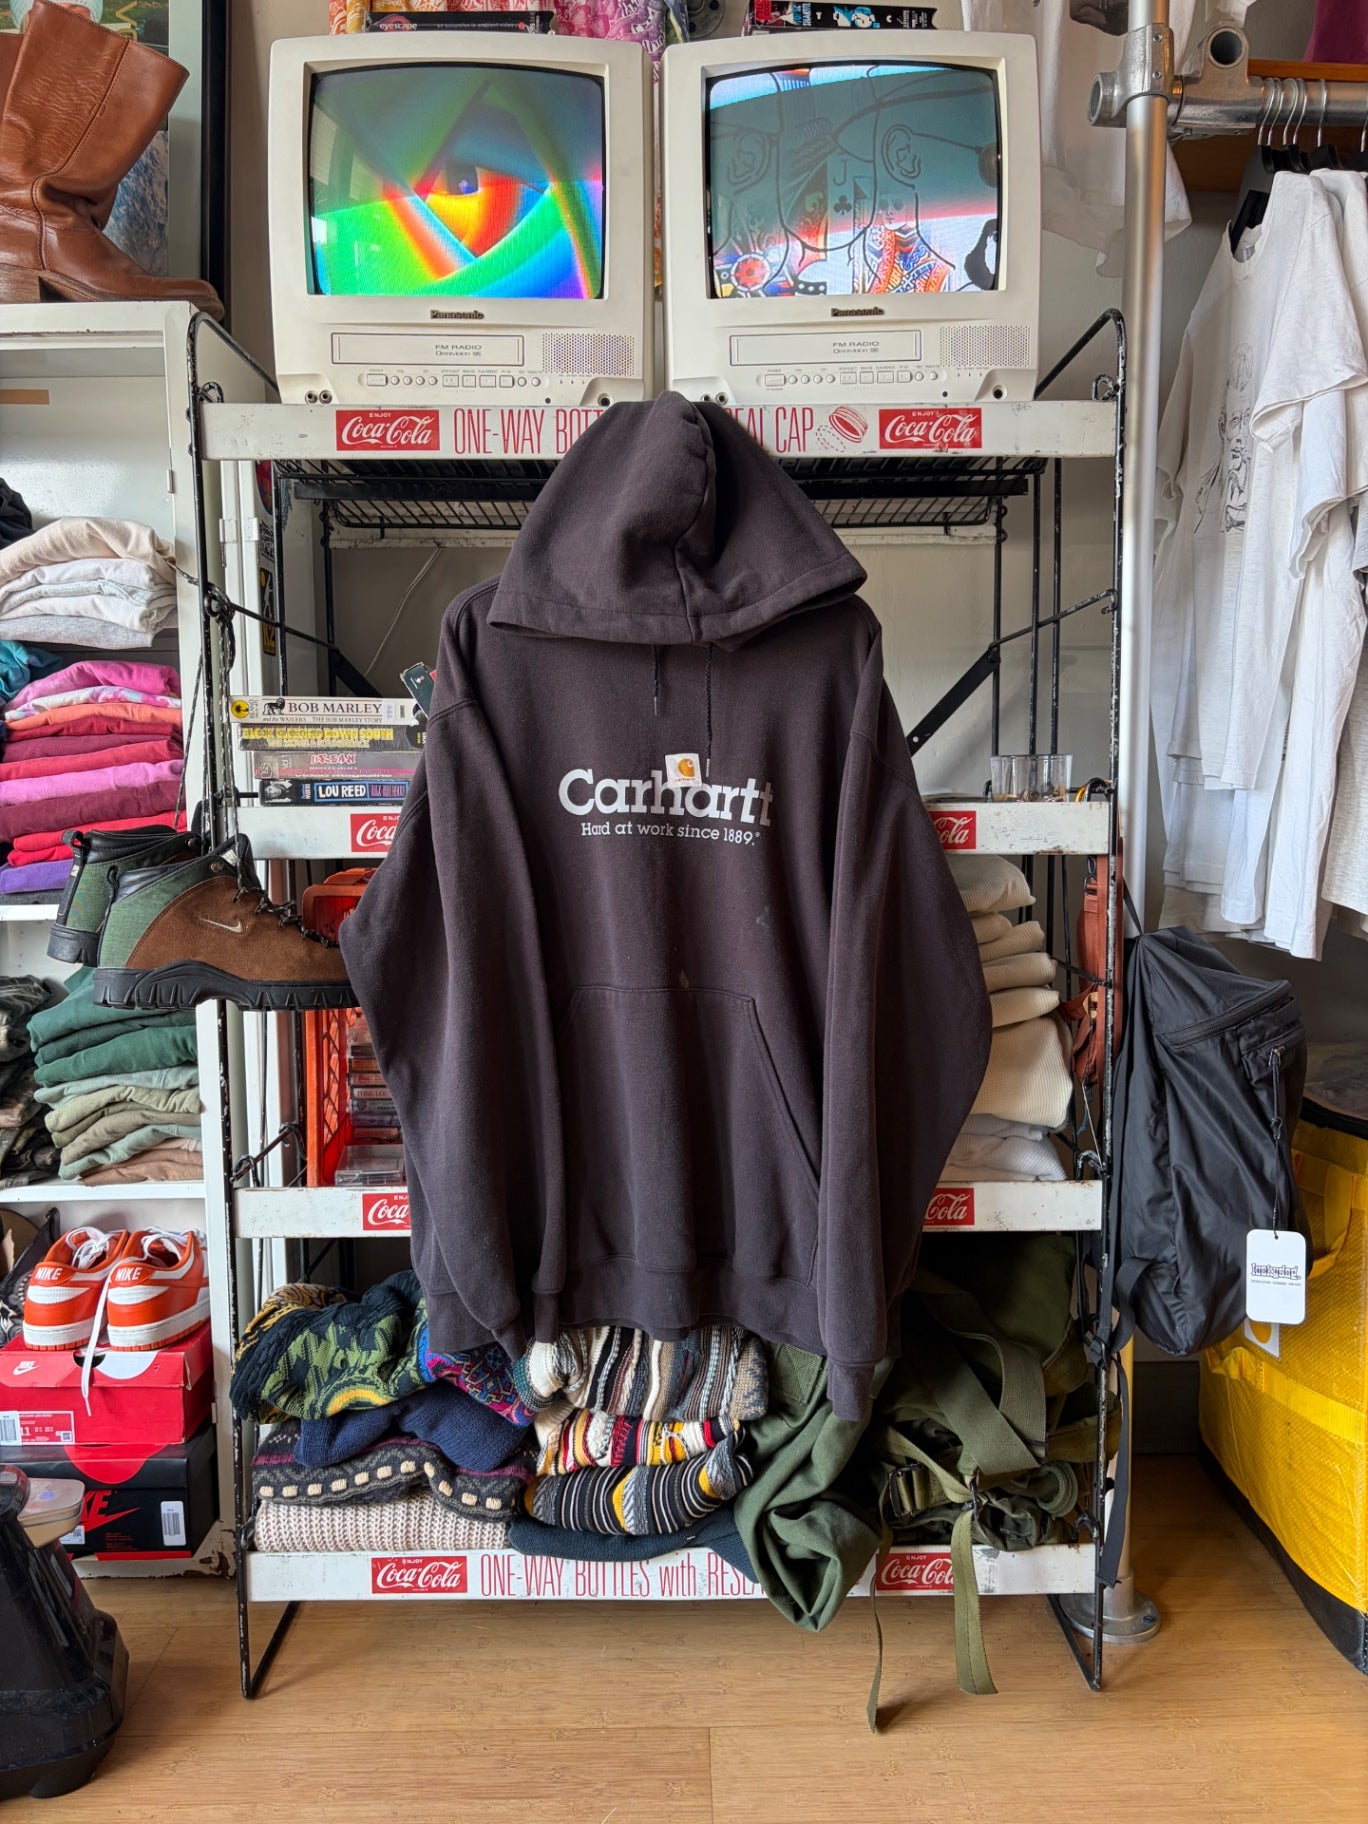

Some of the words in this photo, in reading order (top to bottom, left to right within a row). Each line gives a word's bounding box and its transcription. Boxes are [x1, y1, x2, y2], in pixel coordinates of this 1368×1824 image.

[379, 22, 418, 31] eyescape
[430, 309, 485, 320] Panasonic
[830, 307, 885, 317] Panasonic
[341, 414, 436, 445] Coca-Cola
[453, 408, 545, 455] ONE-WAY
[774, 406, 814, 453] CAP
[884, 413, 978, 444] Coca-Cola
[289, 702, 319, 714] BOB
[322, 702, 383, 714] MARLEY
[359, 728, 394, 741] SOUTH
[318, 785, 339, 798] LOU
[341, 784, 367, 798] REED
[558, 768, 774, 827] Carhartt
[581, 821, 610, 836] Hard
[615, 821, 633, 835] at
[637, 824, 675, 838] work
[677, 825, 720, 840] since
[34, 1267, 64, 1281] NIKE
[115, 1267, 142, 1281] NIKE
[18, 1360, 36, 1369] NIKE
[80, 1489, 112, 1522] KE
[376, 1560, 464, 1589] Coca-Cola
[480, 1553, 564, 1597] ONE-WAY
[659, 1551, 697, 1597] with
